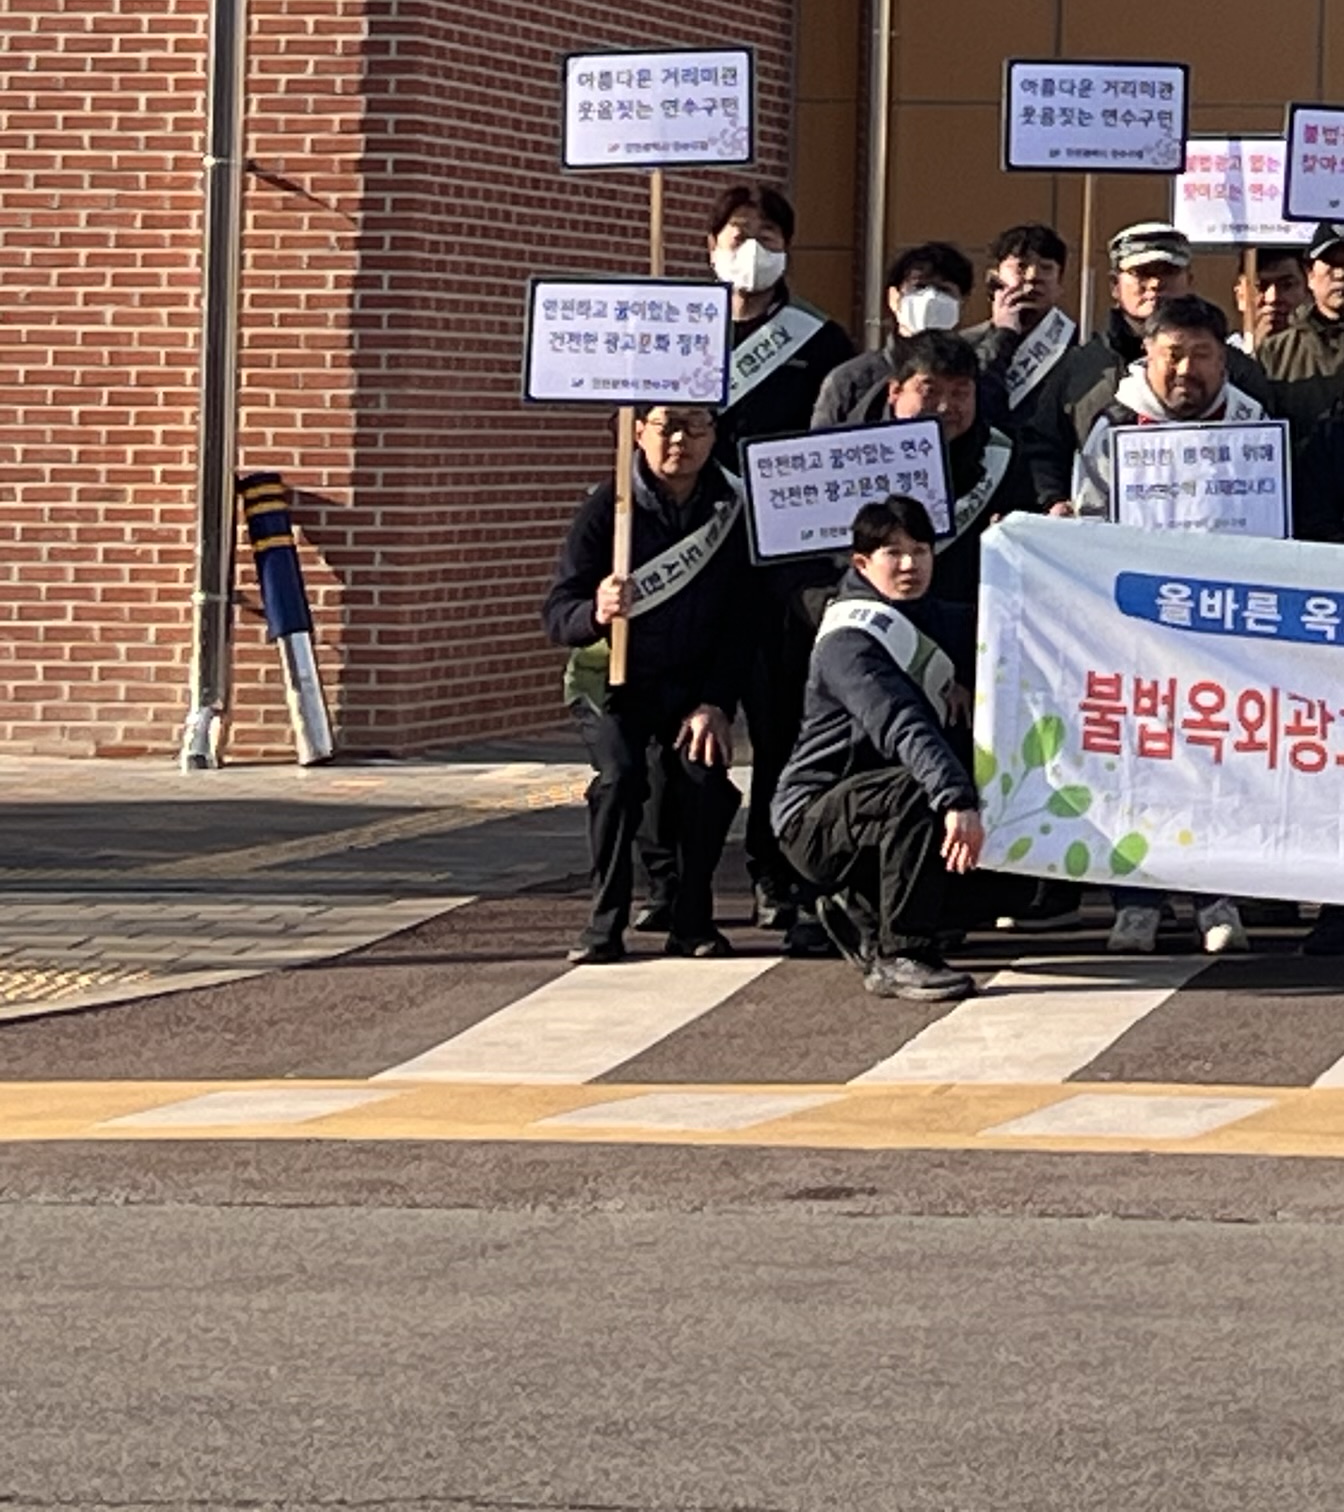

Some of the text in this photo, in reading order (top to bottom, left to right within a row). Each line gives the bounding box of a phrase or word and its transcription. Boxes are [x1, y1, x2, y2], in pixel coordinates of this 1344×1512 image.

[578, 68, 652, 90] 아름다운
[1020, 78, 1174, 100] 아름다운 거리미관
[686, 301, 718, 323] 연수
[901, 438, 933, 459] 연수
[824, 474, 890, 502] 광고문화
[1155, 581, 1283, 633] 올바른
